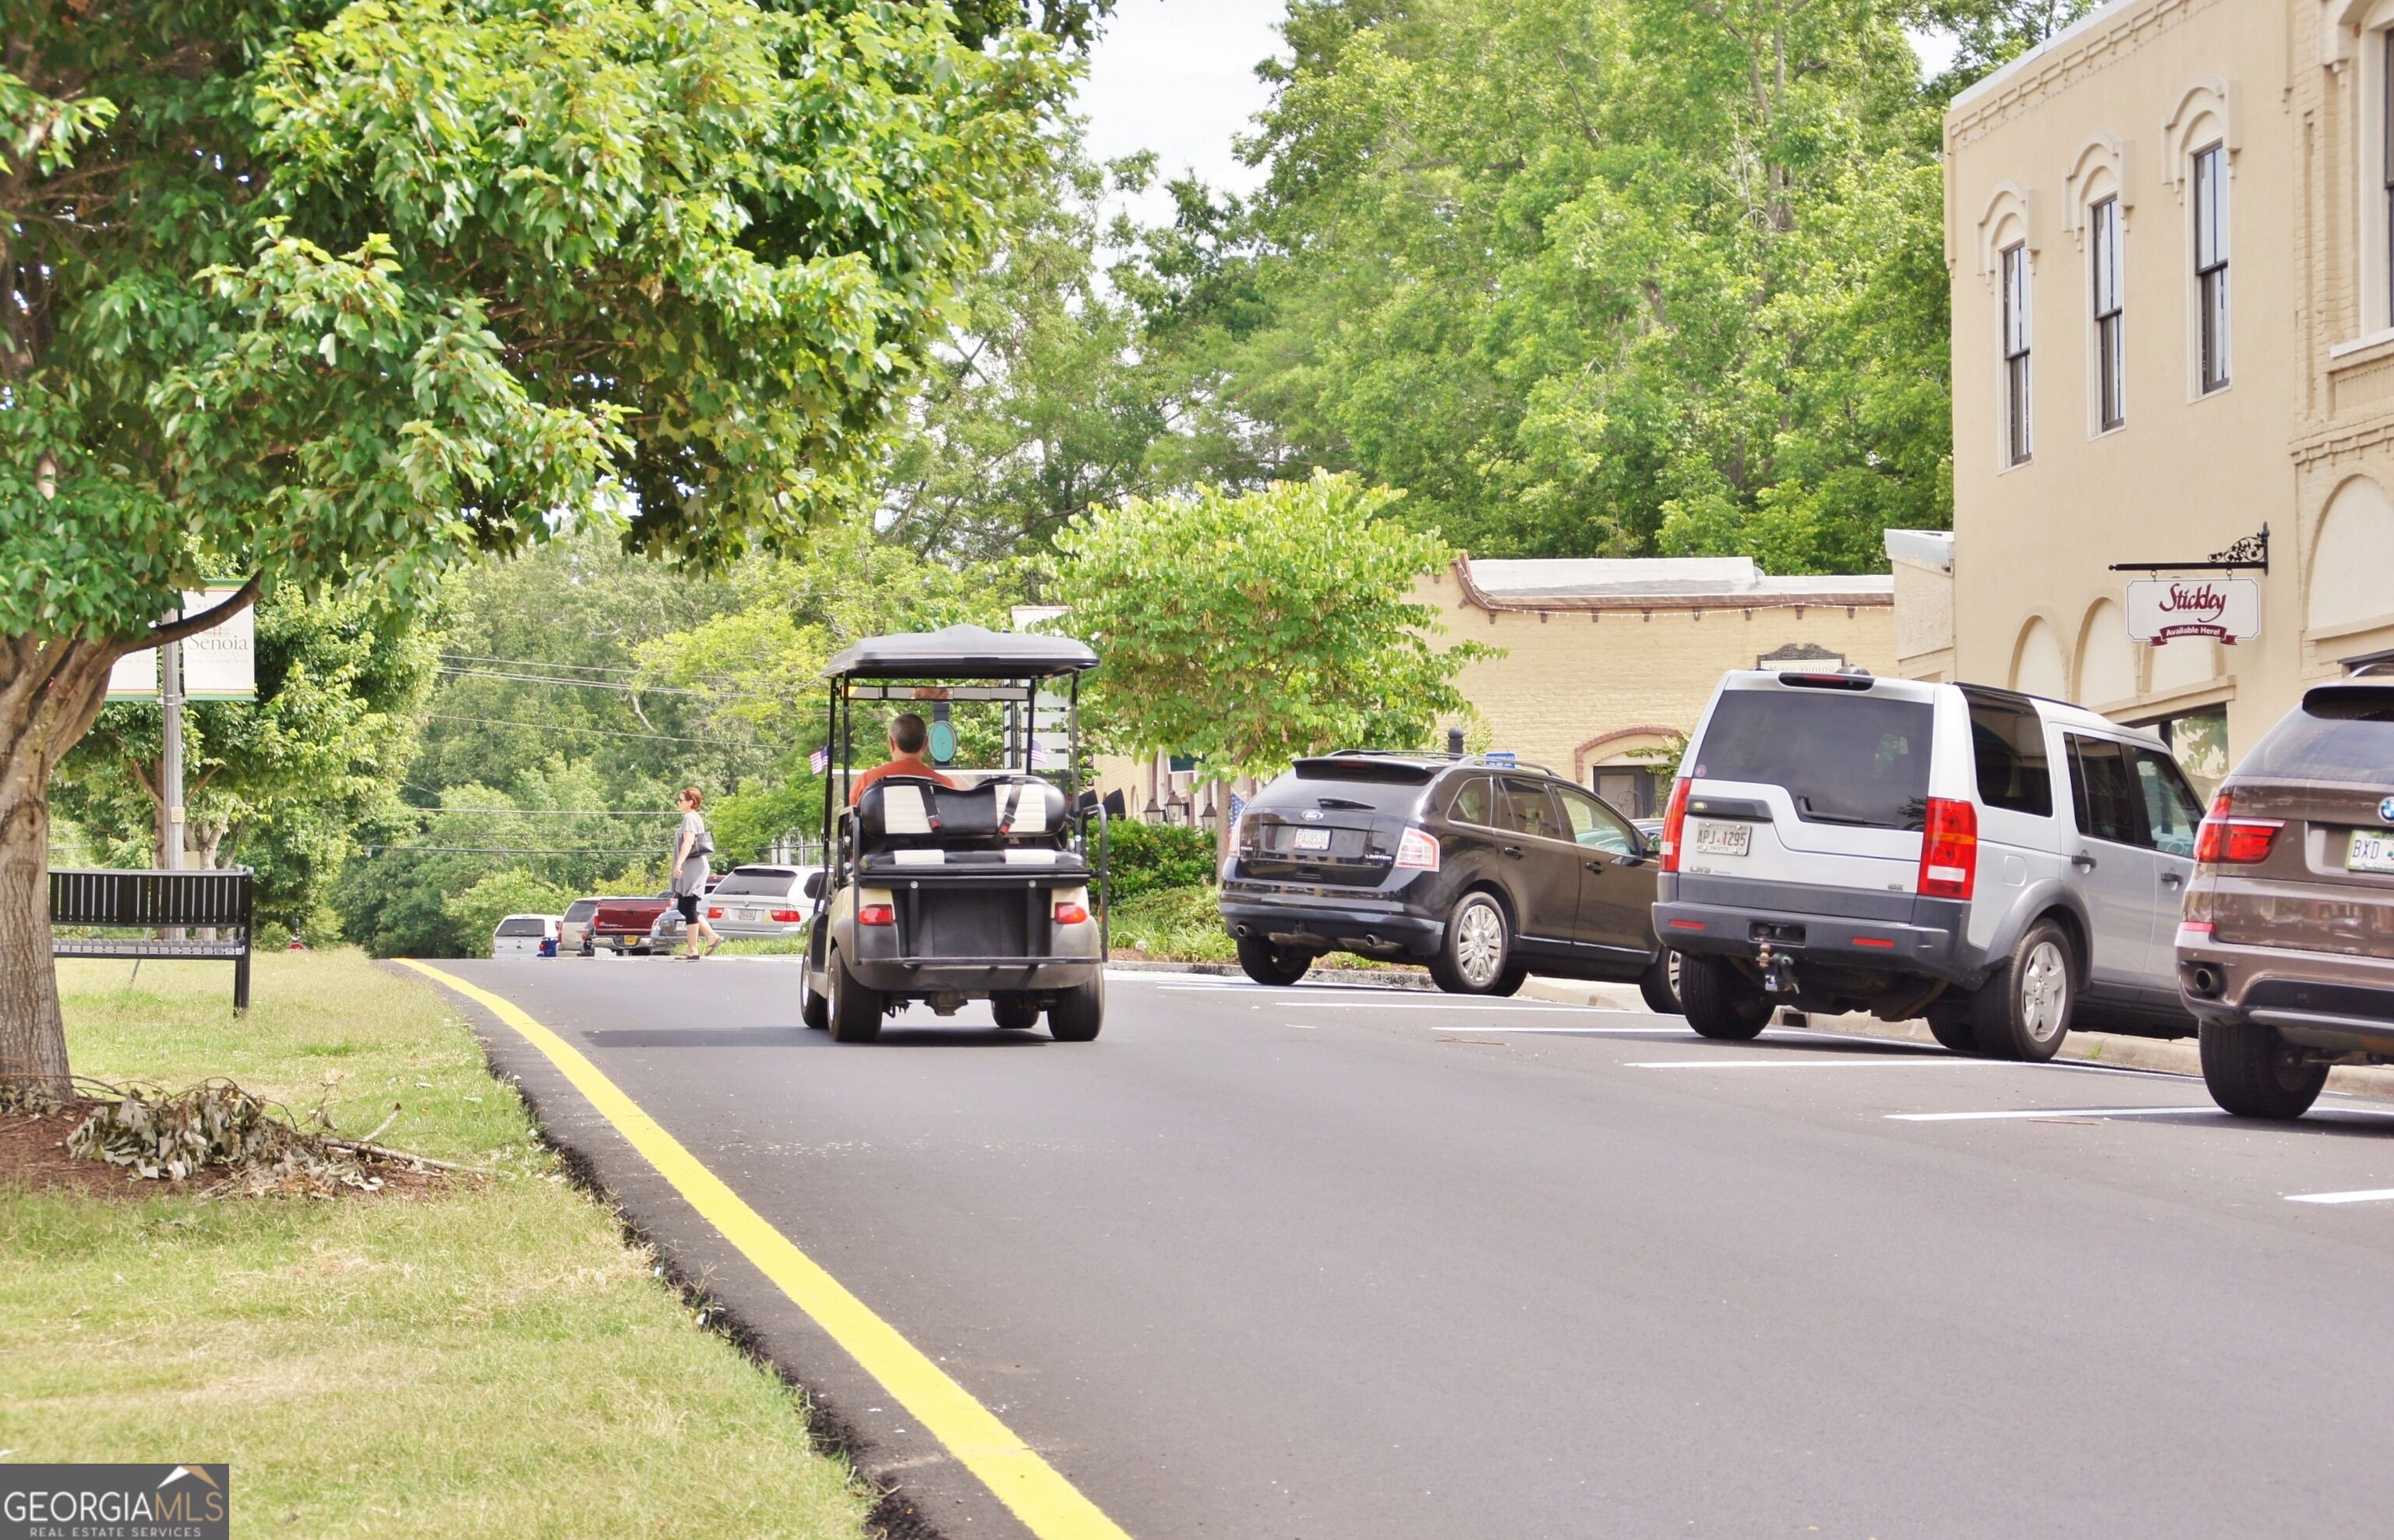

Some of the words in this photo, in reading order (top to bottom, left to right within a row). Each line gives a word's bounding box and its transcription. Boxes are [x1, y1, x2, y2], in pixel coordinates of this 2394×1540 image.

[2159, 583, 2226, 623] Stickley
[2166, 626, 2199, 637] Available
[2200, 626, 2220, 636] Here!
[189, 635, 249, 650] Senoia
[2352, 839, 2381, 859] BXD
